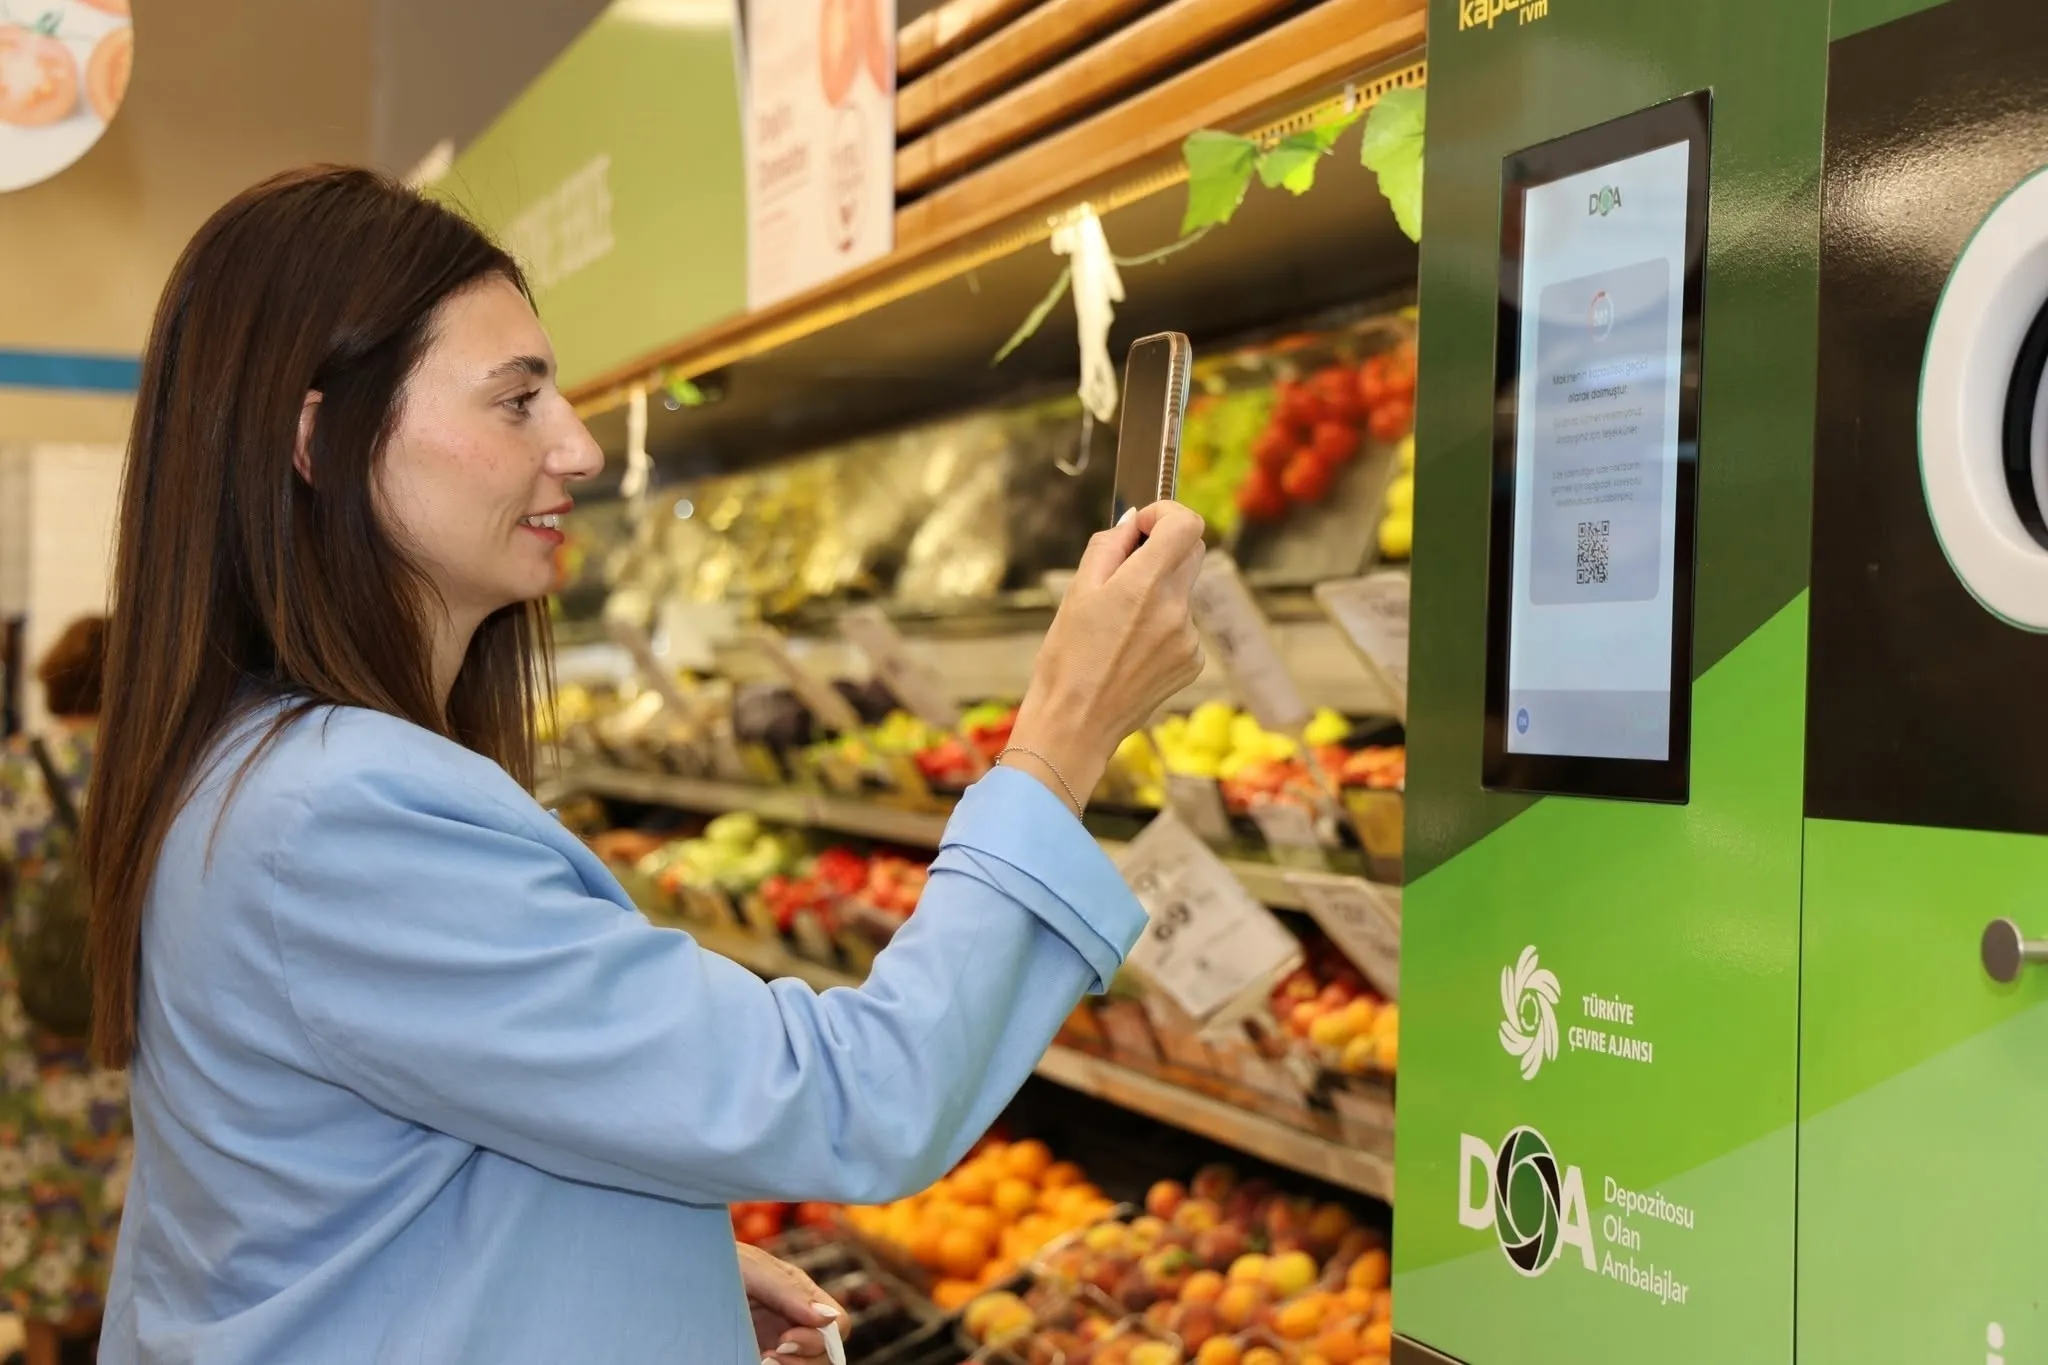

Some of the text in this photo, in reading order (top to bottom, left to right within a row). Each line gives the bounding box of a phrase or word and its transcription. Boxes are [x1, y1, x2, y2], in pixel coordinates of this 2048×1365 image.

[1520, 0, 1548, 26] rvm
[1589, 187, 1621, 216] DOA
[1582, 992, 1634, 1025] TÜRKİYE
[1568, 1026, 1653, 1064] ÇEVRE AJANSI
[1459, 1125, 1598, 1278] DOA
[1604, 1175, 1694, 1230] Depozitosu
[1603, 1214, 1641, 1251] Olan
[1602, 1250, 1690, 1306] Ambalajlar
